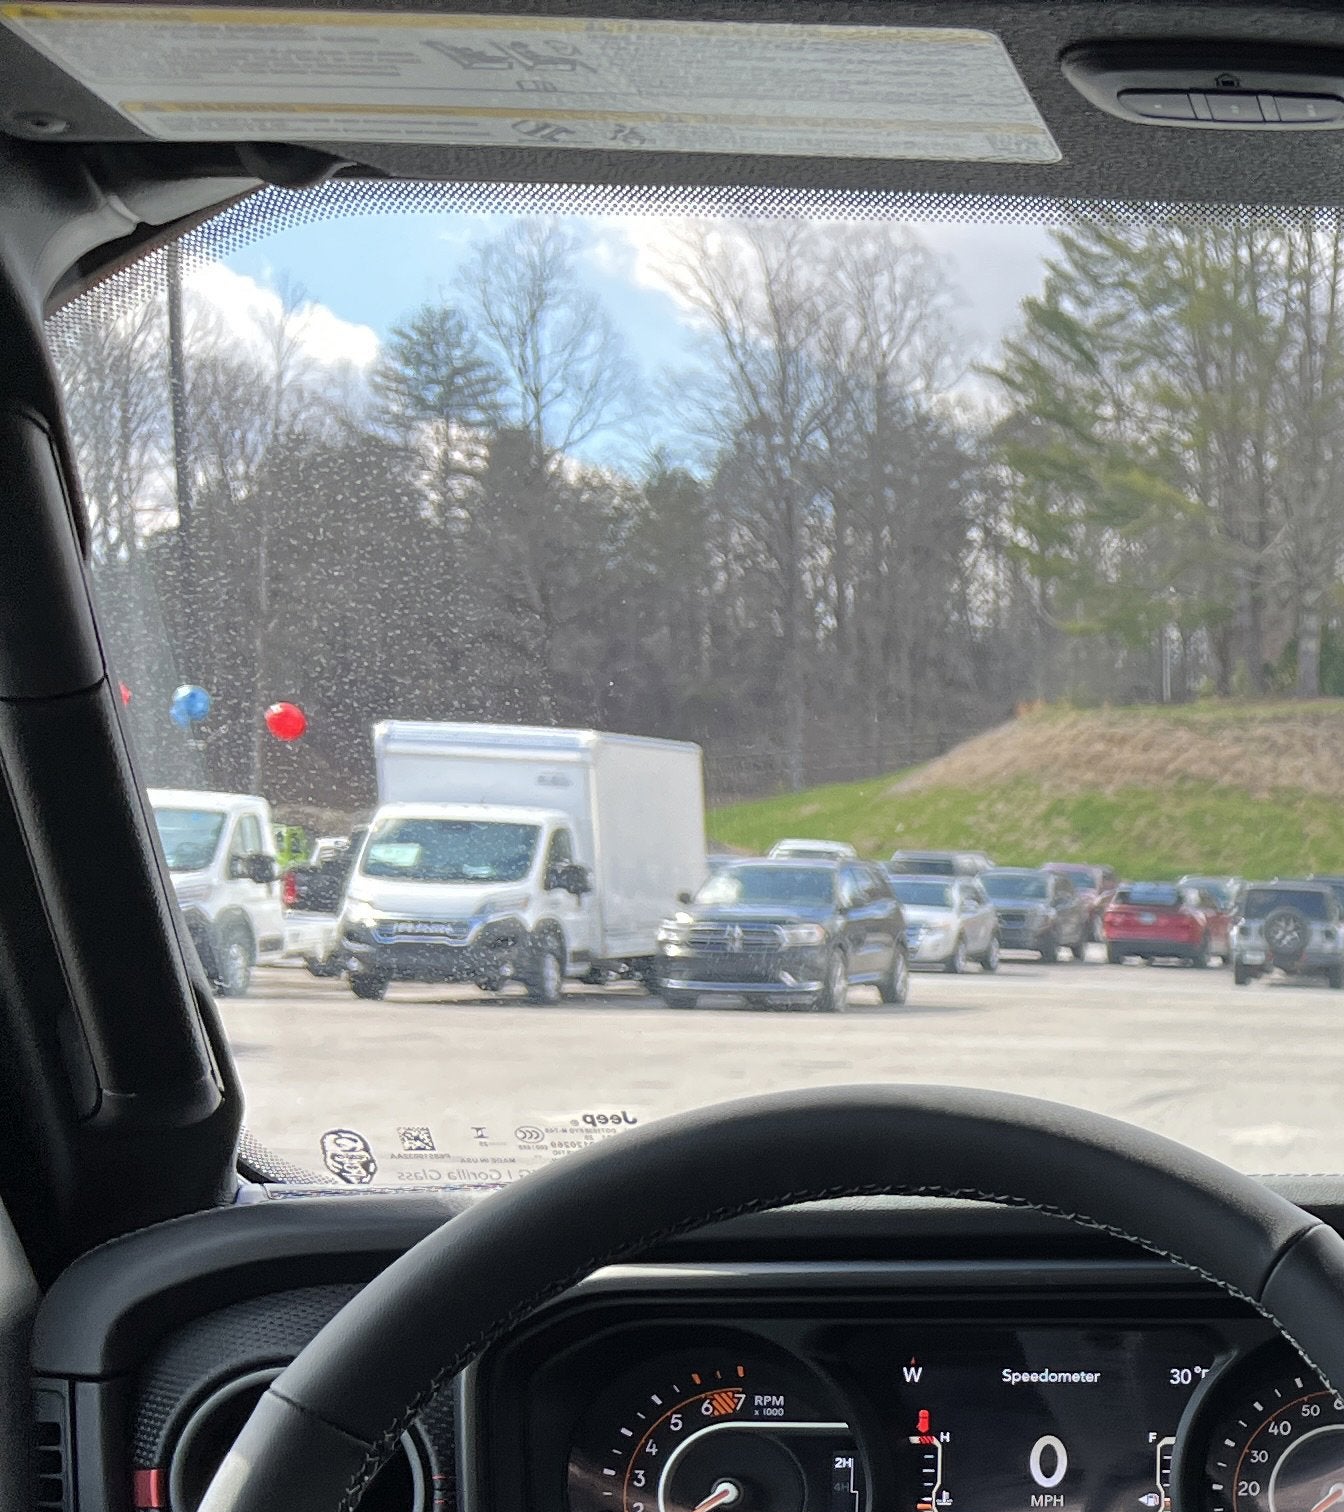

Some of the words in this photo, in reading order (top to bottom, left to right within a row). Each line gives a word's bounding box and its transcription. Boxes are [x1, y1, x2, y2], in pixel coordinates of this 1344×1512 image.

[903, 1367, 923, 1383] W
[1001, 1368, 1101, 1385] Speedometer
[700, 1398, 714, 1416] 6
[733, 1393, 746, 1412] 7
[754, 1395, 785, 1406] RPM
[763, 1408, 785, 1417] 1000
[1301, 1404, 1321, 1417] 50
[669, 1414, 683, 1431] 5
[1268, 1420, 1292, 1436] 40
[940, 1432, 951, 1443] H
[1148, 1432, 1157, 1443] F
[645, 1439, 658, 1456] 4
[834, 1457, 852, 1468] 2H
[1029, 1434, 1068, 1488] 0
[1250, 1450, 1269, 1463] 30
[633, 1469, 646, 1487] 3
[1238, 1480, 1261, 1496] 20
[1030, 1495, 1065, 1507] MPH
